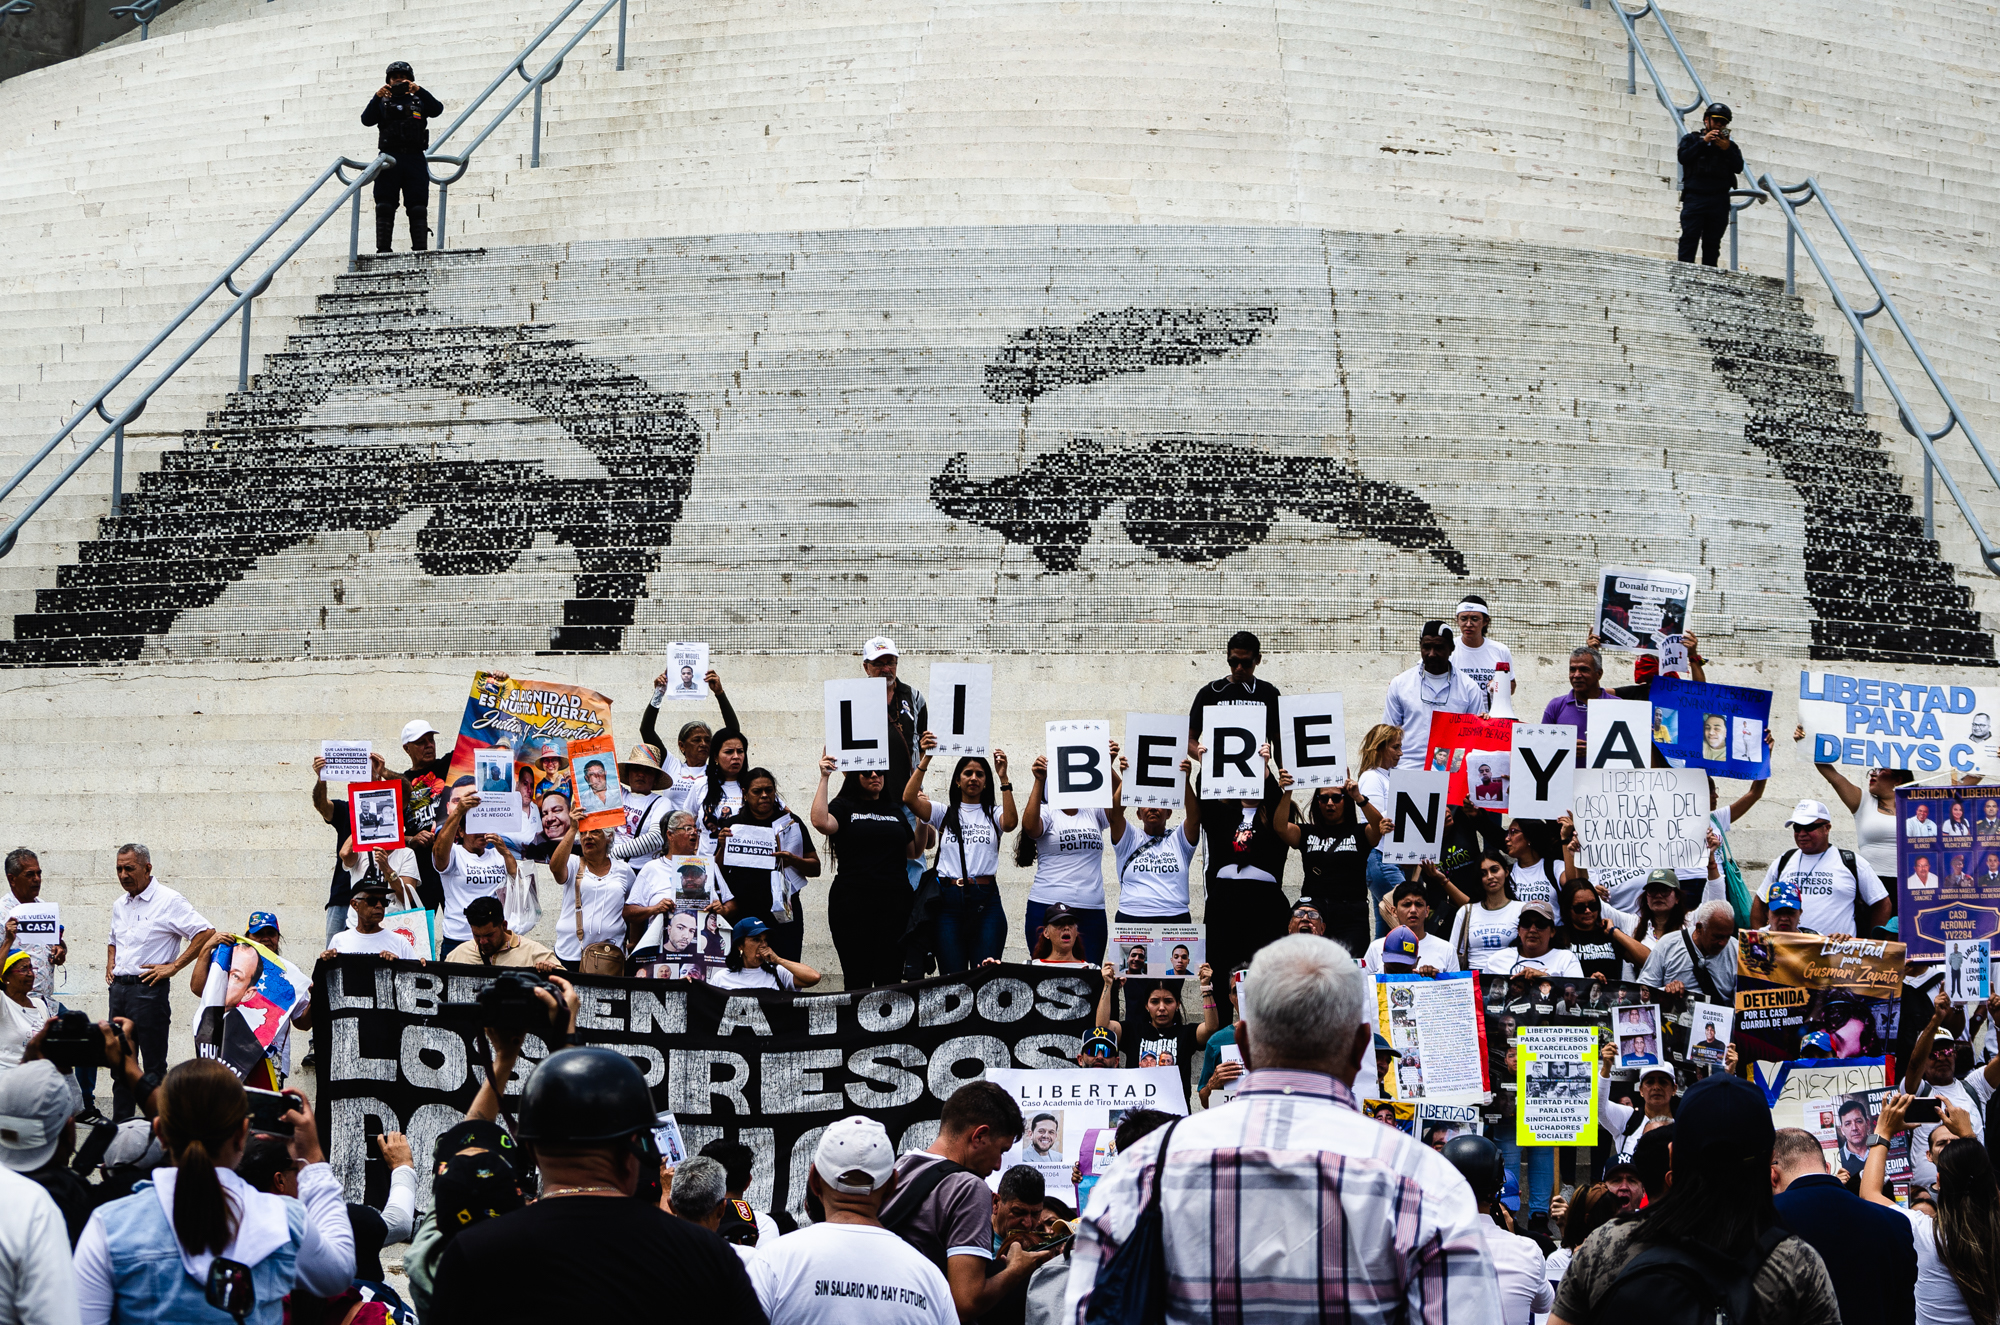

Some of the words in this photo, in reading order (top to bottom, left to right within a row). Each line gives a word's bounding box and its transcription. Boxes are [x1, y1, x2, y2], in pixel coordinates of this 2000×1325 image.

[1620, 582, 1648, 592] Donald
[1651, 584, 1684, 596] Trump's
[520, 690, 582, 708] DIGNIDAD
[1660, 680, 1708, 697] JUSTICIA
[1716, 686, 1766, 703] LIBERTAD
[1800, 670, 1976, 715] LIBERTAD
[478, 694, 496, 708] ES
[499, 700, 538, 716] NUESTRA
[541, 704, 604, 726] FUERZA.
[952, 684, 966, 735] I
[472, 710, 522, 734] Justicia
[522, 723, 532, 742] y
[531, 718, 606, 740] Libertad
[840, 700, 878, 750] L
[1846, 704, 1944, 741] PARA
[1293, 714, 1336, 768] E
[1592, 720, 1646, 768] A
[1136, 734, 1177, 788] E
[1212, 727, 1257, 778] R
[1814, 733, 1942, 772] DENYS
[1948, 744, 1980, 772] C.
[1056, 745, 1104, 793] B
[1518, 748, 1570, 801] Y
[1908, 789, 1948, 800] JUSTICIA
[1950, 789, 1957, 798] Y
[1575, 794, 1608, 819] CASO
[1618, 794, 1658, 818] FUGA
[1673, 793, 1701, 817] DEL
[1393, 791, 1440, 844] N
[1060, 834, 1076, 842] LOS
[1585, 820, 1600, 842] EX
[1604, 819, 1656, 840] ALCALDE
[1668, 818, 1685, 840] DE
[742, 839, 773, 847] ANUNCIOS
[743, 847, 773, 856] BASTAN
[1133, 864, 1179, 873] POLÍTICOS
[1940, 921, 1976, 930] AERONAVE
[1949, 911, 1968, 920] CASO
[1472, 928, 1512, 938] IMPULSO
[1944, 931, 1972, 939] YV2284
[1820, 937, 1888, 959] Libertad
[1963, 944, 1988, 960] LIBERTAD
[1840, 957, 1862, 968] para
[1803, 961, 1856, 980] Gusmari
[1856, 965, 1900, 988] Zapata
[1743, 990, 1806, 1008] DETENIDA
[1967, 987, 1979, 996] YA!
[717, 996, 772, 1036] A
[793, 977, 1092, 1036] TODOS
[1703, 1010, 1724, 1018] GABRIEL
[1744, 1010, 1758, 1020] POR
[1760, 1009, 1768, 1019] EL
[1770, 1008, 1788, 1018] CASO
[1740, 1018, 1771, 1030] GUARDIA
[1772, 1018, 1781, 1027] DE
[1783, 1015, 1803, 1026] HONOR
[330, 1016, 555, 1096] LOS
[1022, 1084, 1157, 1099] LIBERTAD
[1114, 1098, 1156, 1106] Maracaibo
[1419, 1103, 1476, 1121] LIBERTAD
[1886, 1158, 1910, 1170] EDIDA
[815, 1280, 829, 1296] SIN
[830, 1280, 864, 1299] SALARIO
[866, 1284, 879, 1300] NO
[881, 1285, 898, 1302] HAY
[900, 1288, 927, 1310] FUTURO
